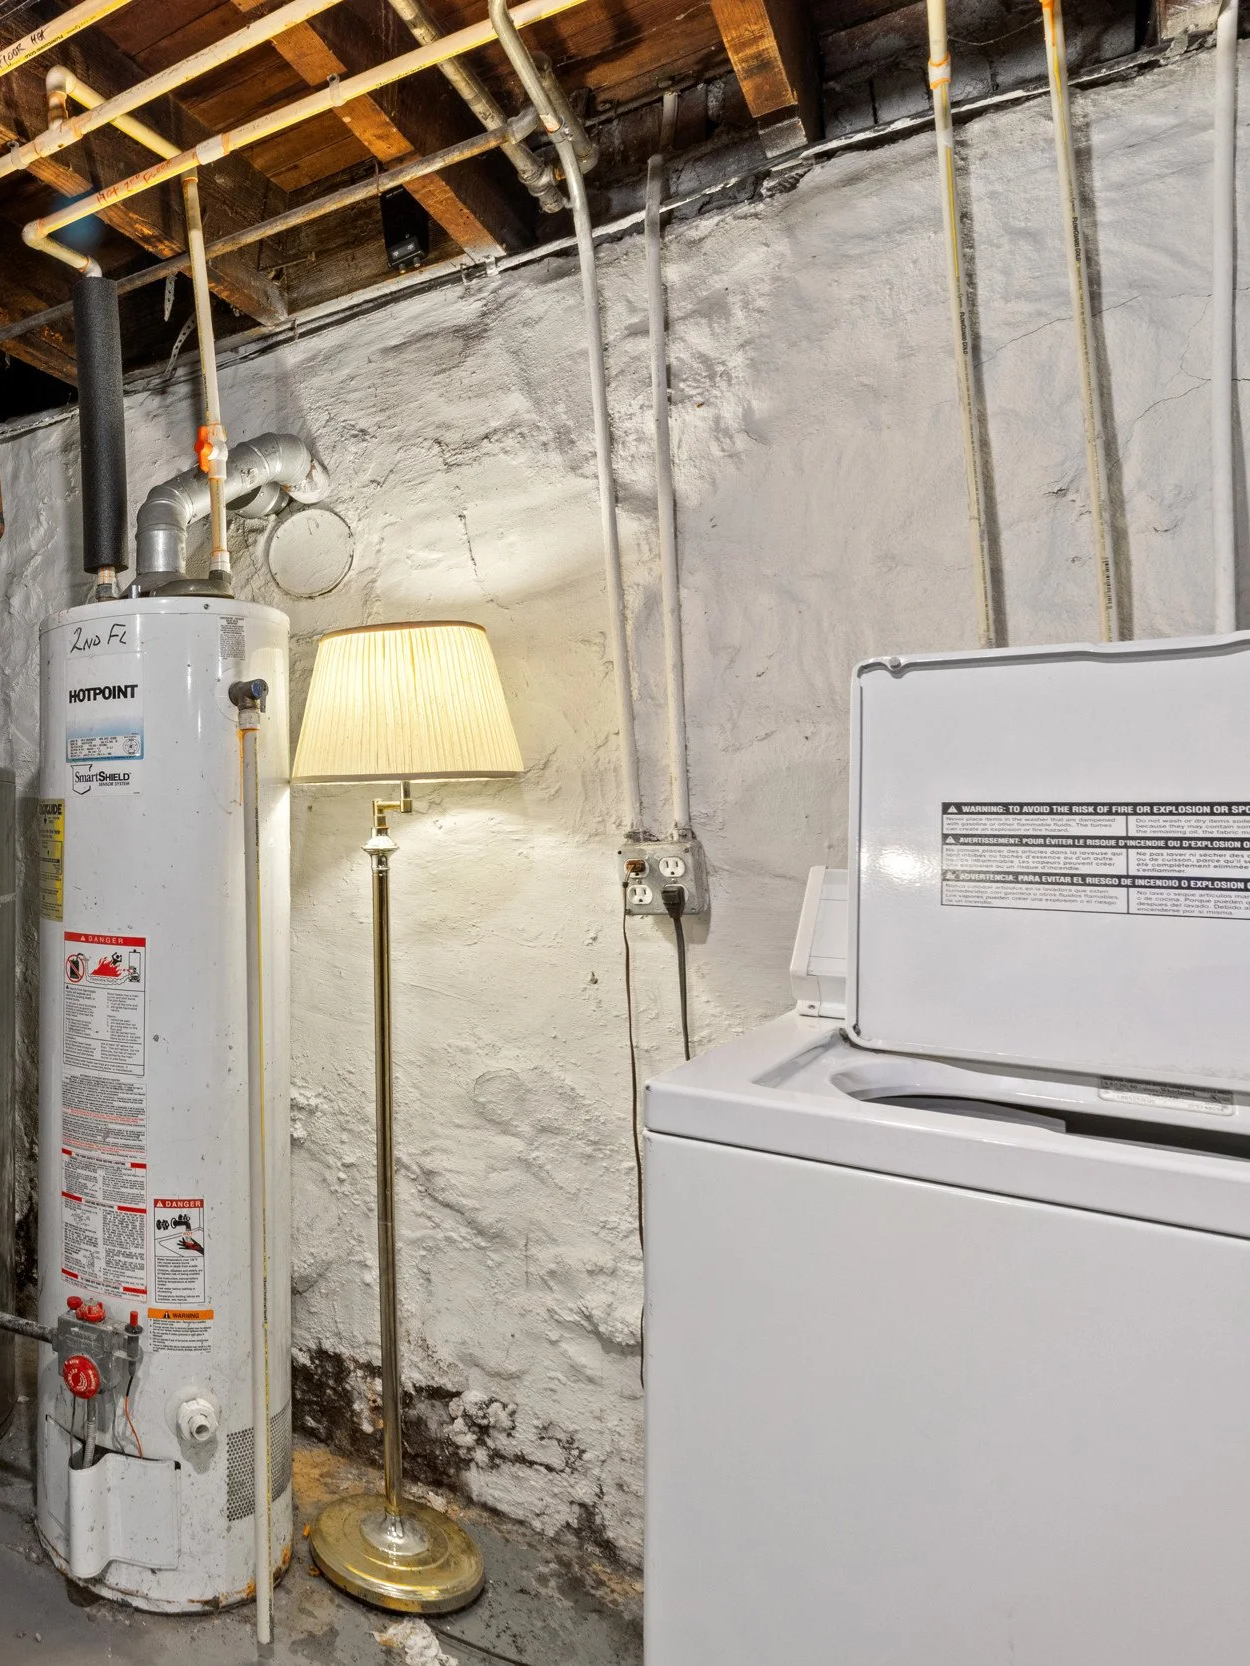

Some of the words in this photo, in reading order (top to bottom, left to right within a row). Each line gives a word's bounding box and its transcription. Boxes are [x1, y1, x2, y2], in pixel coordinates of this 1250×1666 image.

[70, 627, 101, 653] 2ND
[69, 684, 138, 704] HOTPOINT
[961, 805, 1006, 813] WARNING:
[1008, 805, 1020, 813] TO
[1022, 805, 1050, 813] AVOID
[1052, 805, 1070, 813] THE
[1072, 805, 1095, 813] RISK
[1097, 805, 1110, 813] OF
[1112, 805, 1134, 813] FIRE
[1136, 805, 1151, 813] OR
[1153, 805, 1211, 813] EXPLOSION
[1213, 805, 1229, 813] OR
[1046, 836, 1073, 846] ÉVITER
[1086, 839, 1117, 847] RISQUE
[1118, 839, 1166, 847] D'INCENDIE
[1182, 840, 1241, 848] D'EXPLOSION
[1042, 875, 1071, 883] EVITAR
[1073, 876, 1083, 884] EL
[1085, 877, 1119, 885] RIESGO
[1120, 878, 1133, 886] DE
[1135, 878, 1179, 887] INCENDIO
[1190, 880, 1245, 889] EXPLOSION
[88, 936, 124, 944] DANGER
[165, 1200, 201, 1208] DANGER
